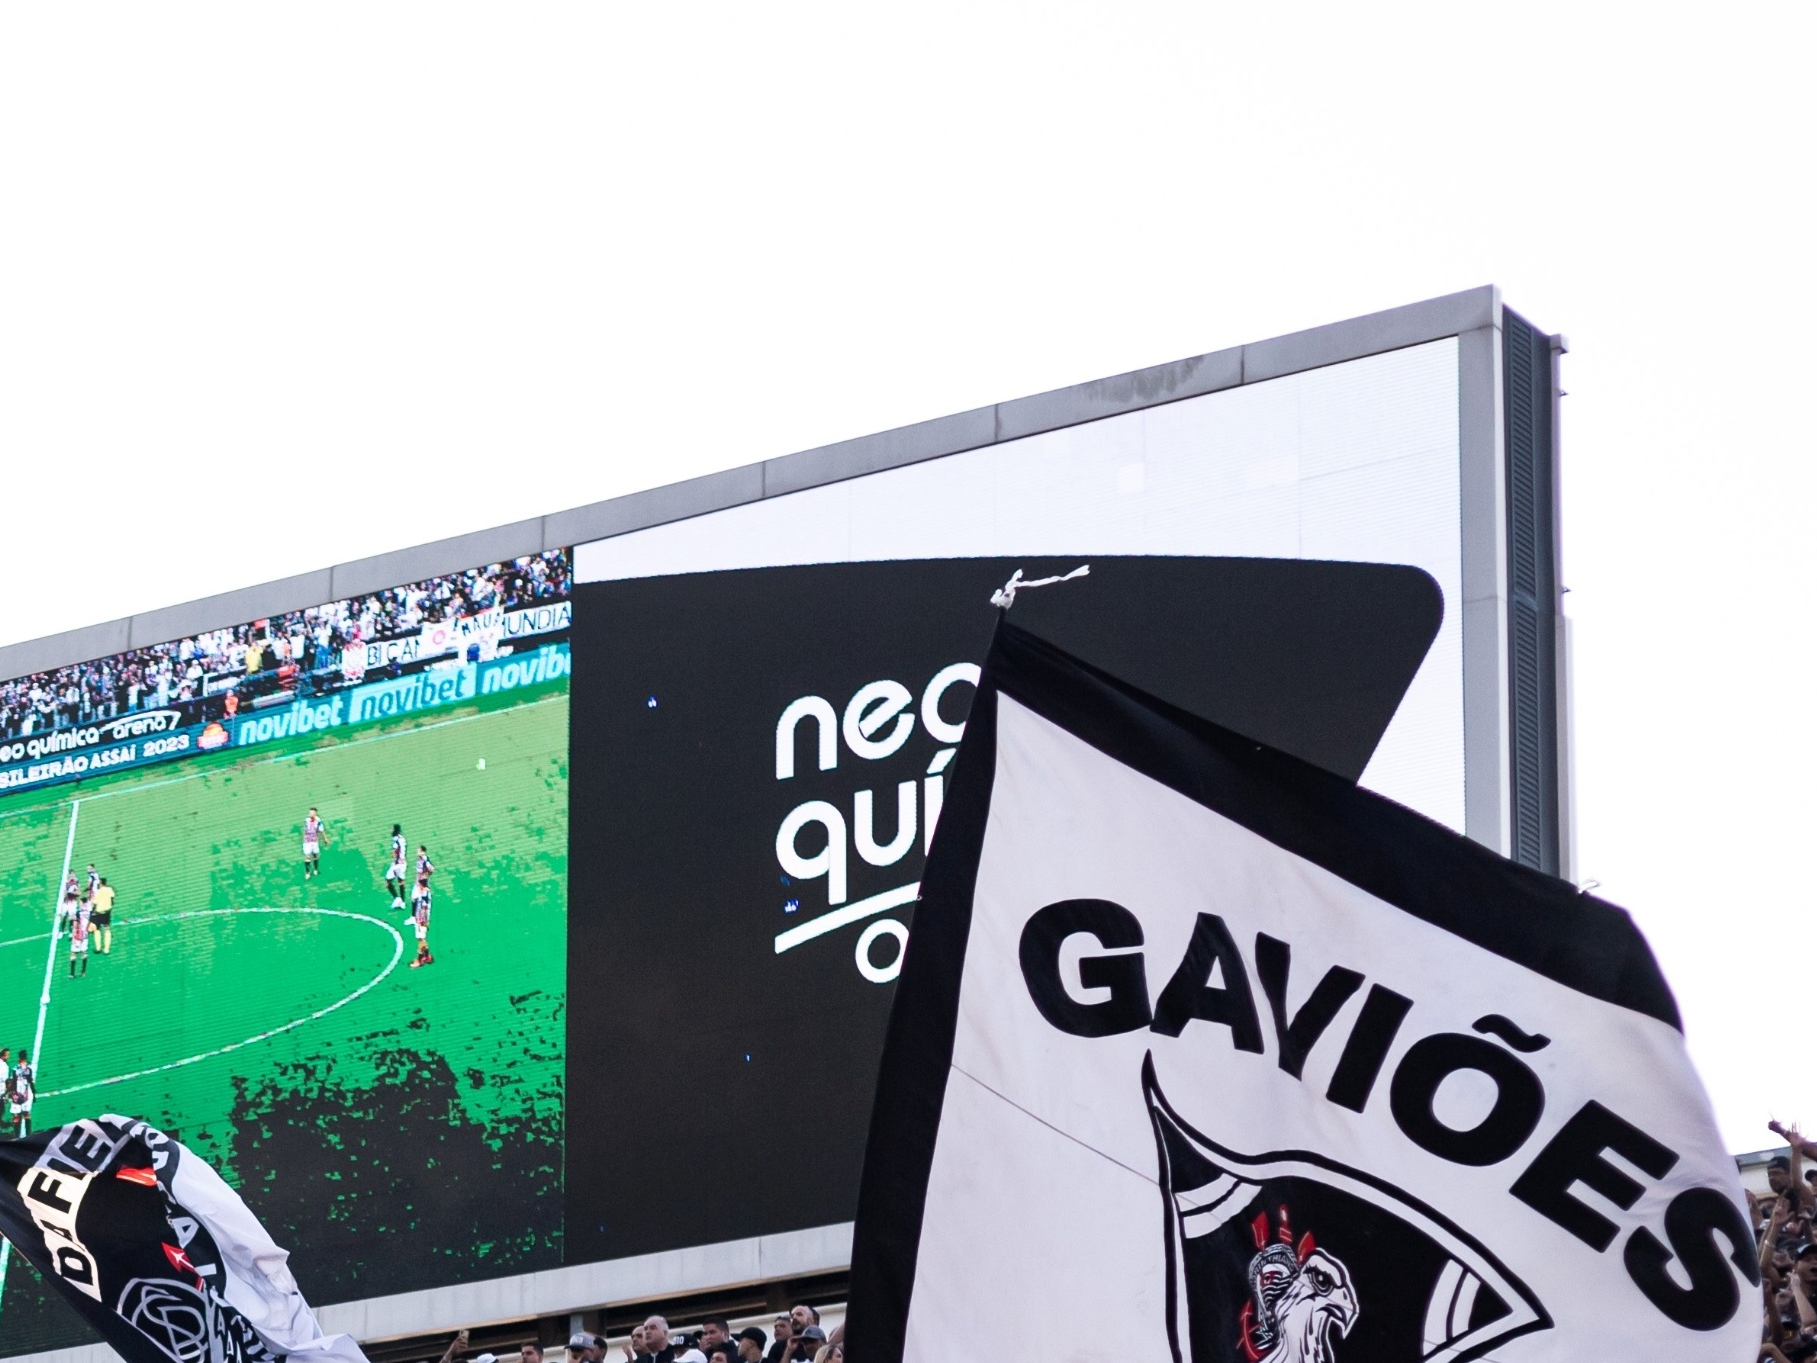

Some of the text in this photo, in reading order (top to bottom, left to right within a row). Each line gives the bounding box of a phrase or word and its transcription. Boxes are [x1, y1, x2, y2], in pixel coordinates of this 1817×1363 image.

[27, 730, 100, 761] química
[112, 715, 167, 742] arena
[239, 692, 342, 746] novibet
[361, 667, 469, 722] novibet
[142, 734, 191, 758] 2023
[775, 747, 958, 906] quí
[855, 917, 910, 984] o
[1018, 897, 1761, 1332] GAVIÕES
